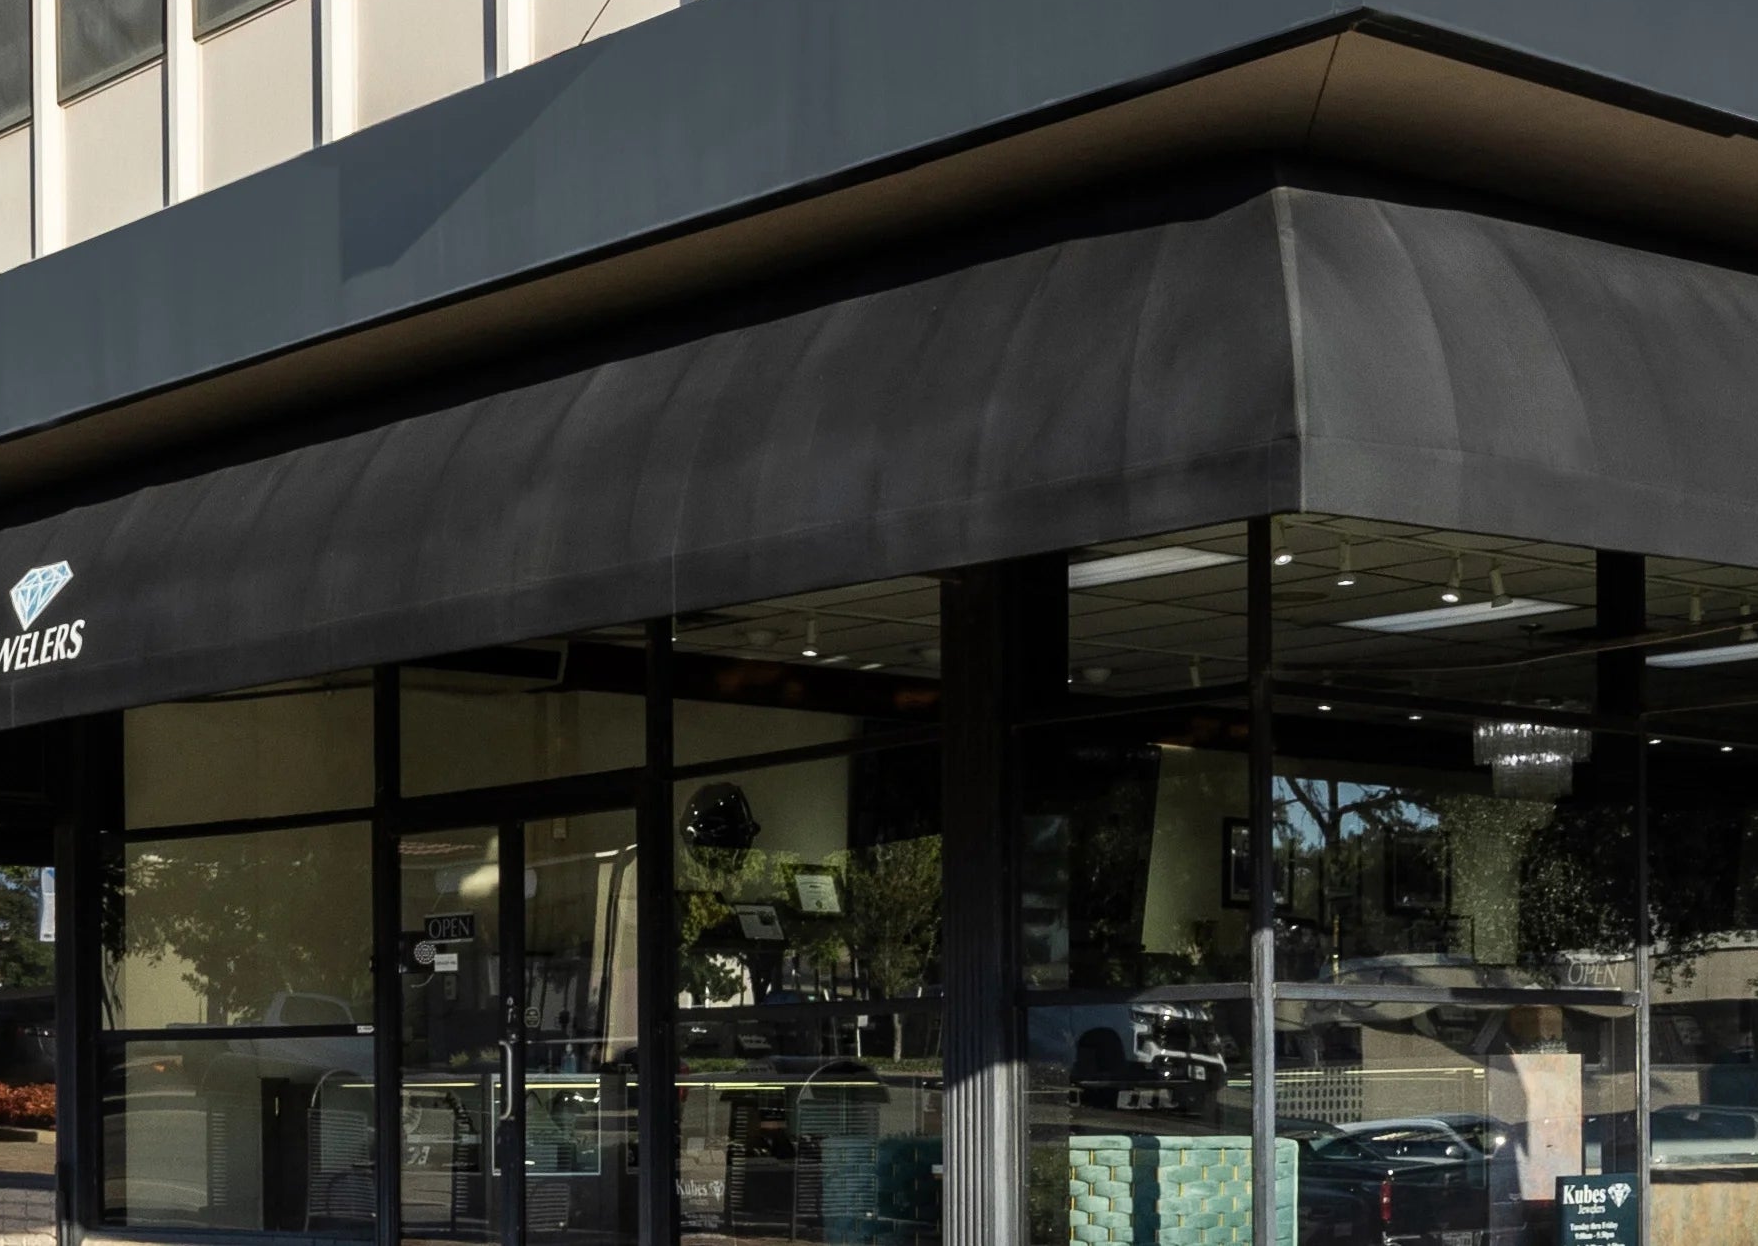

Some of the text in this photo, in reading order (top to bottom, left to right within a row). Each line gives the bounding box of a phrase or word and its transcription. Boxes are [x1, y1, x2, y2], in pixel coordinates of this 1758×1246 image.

[428, 917, 471, 939] OPEN
[1567, 961, 1619, 986] OPEN
[1562, 1183, 1607, 1205] Kubes
